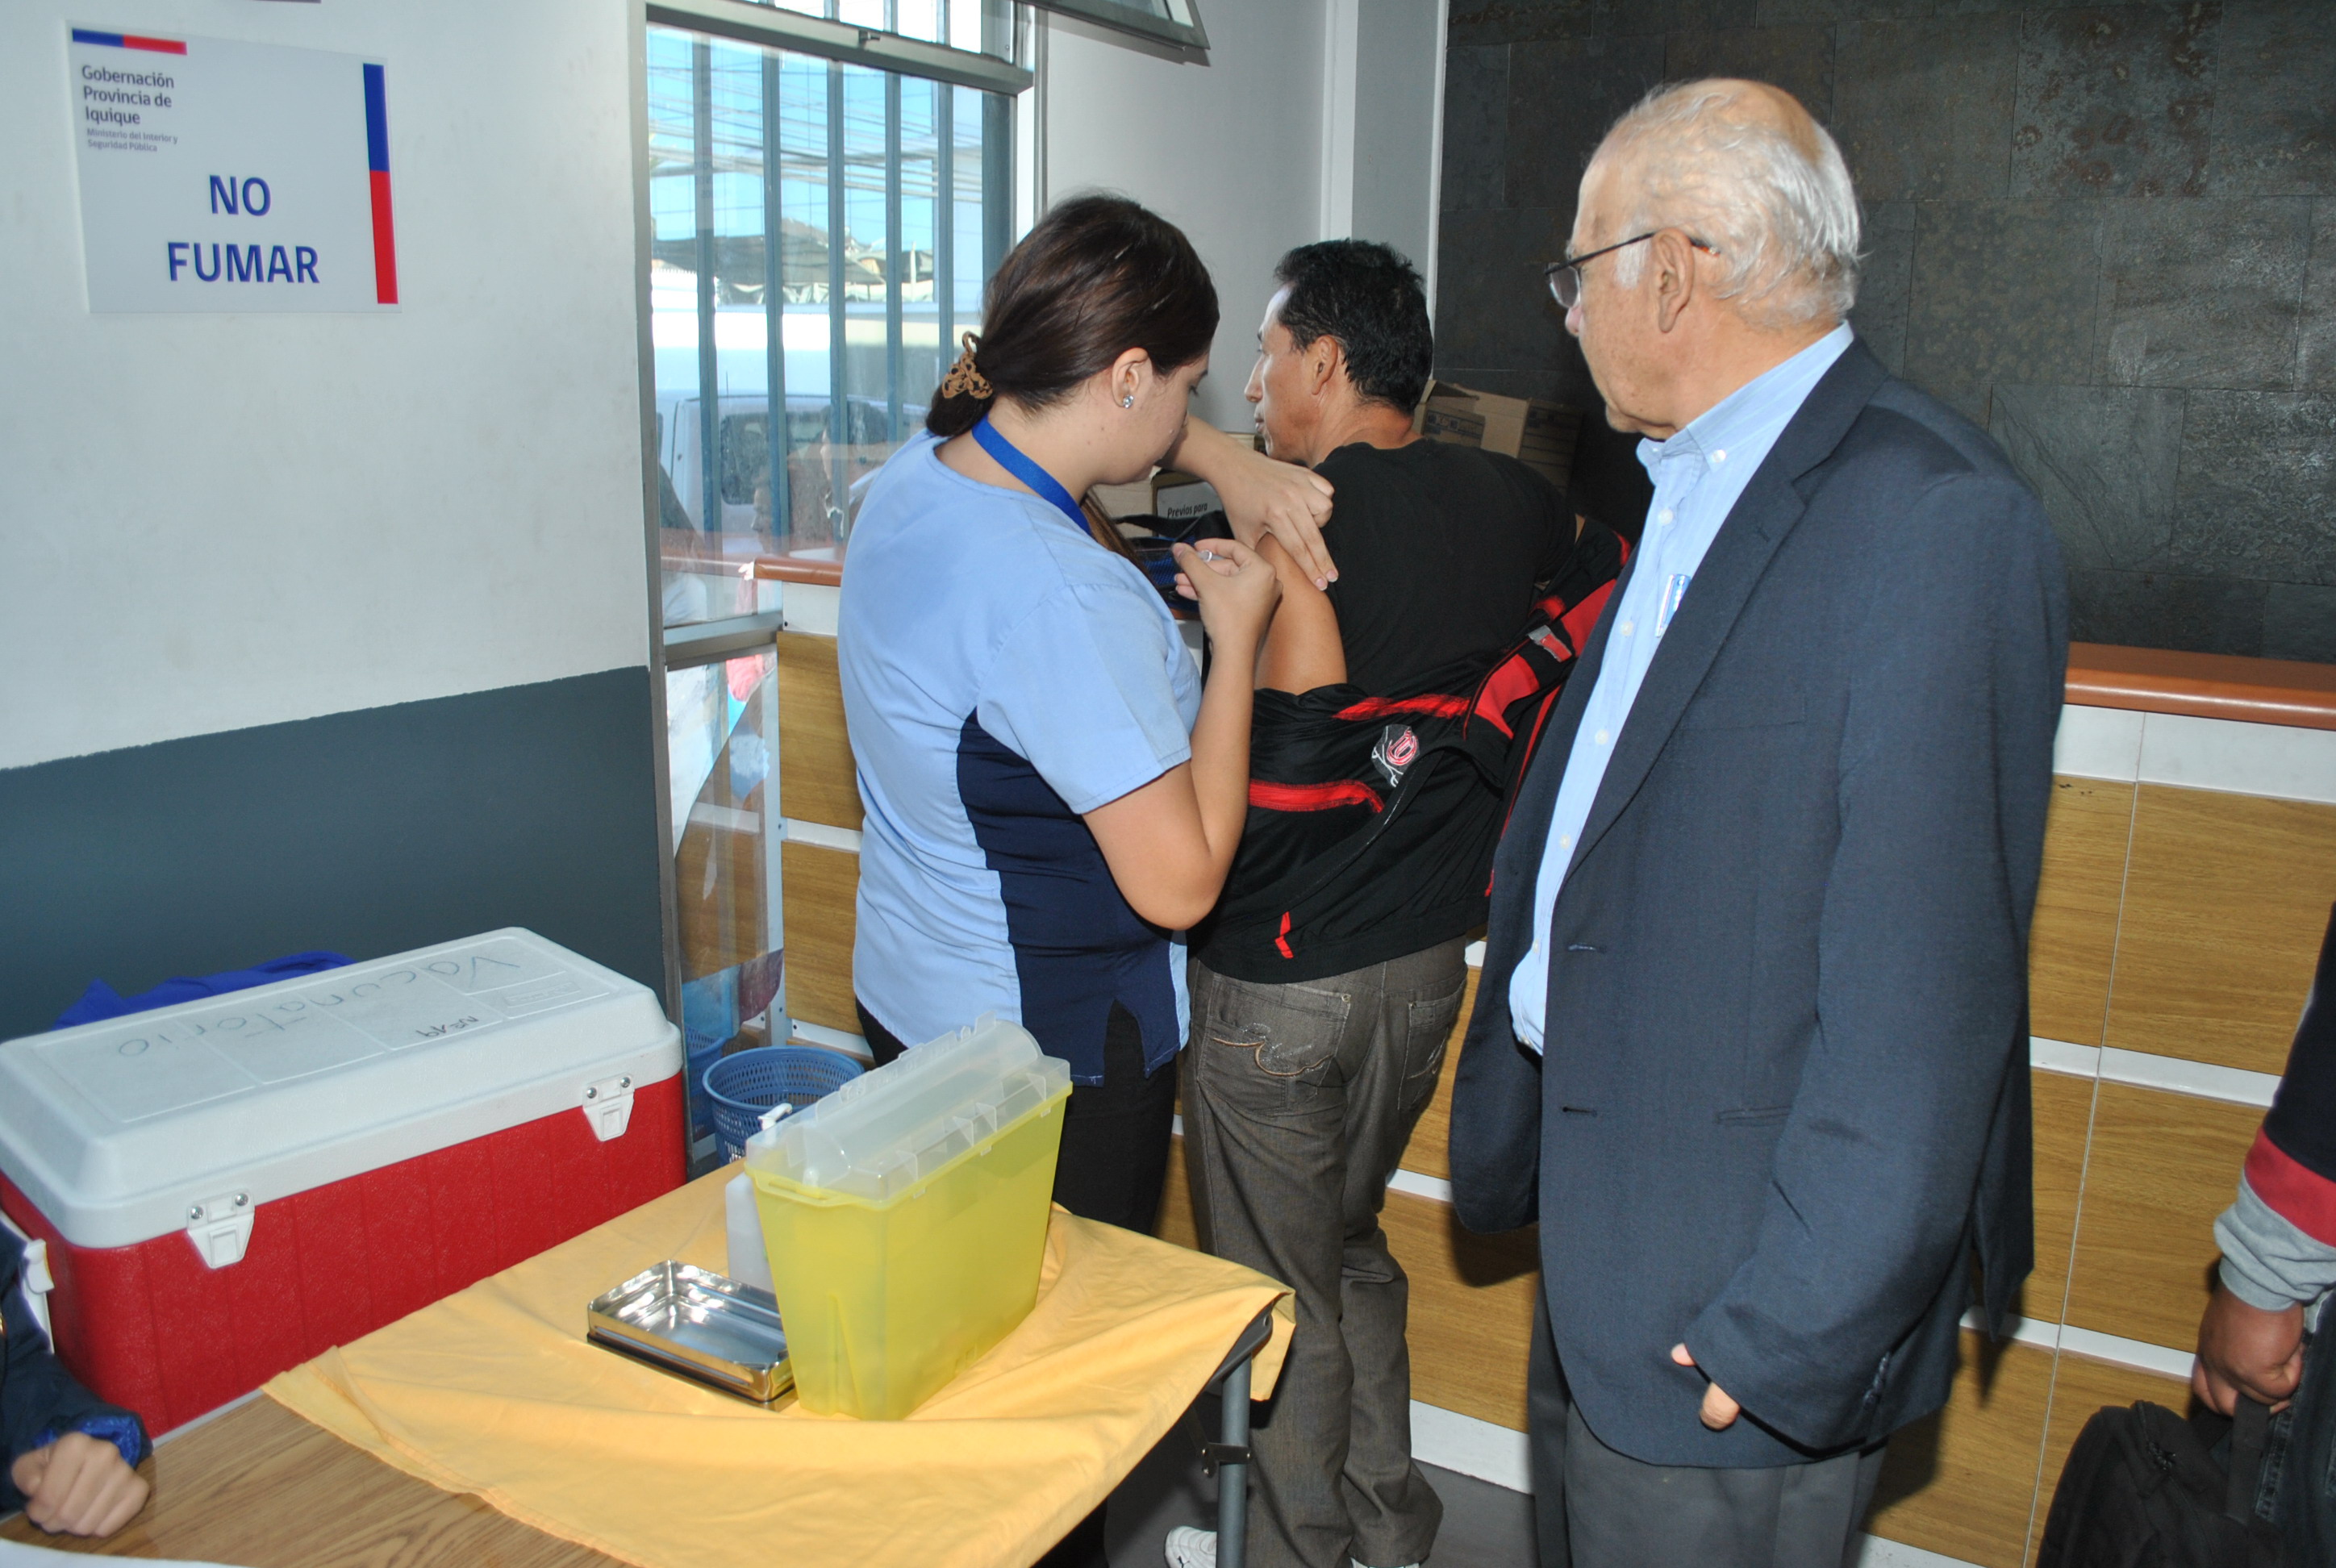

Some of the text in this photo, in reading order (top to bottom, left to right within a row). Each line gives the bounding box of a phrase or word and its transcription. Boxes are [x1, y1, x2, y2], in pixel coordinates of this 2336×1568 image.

[81, 65, 175, 89] Gobernación
[83, 85, 172, 107] Provincia de
[86, 106, 141, 127] Iquique
[86, 127, 178, 145] Ministerio del Interior y
[87, 139, 158, 152] Seguridad Pública
[210, 174, 272, 217] NO
[168, 242, 320, 284] FUMAR
